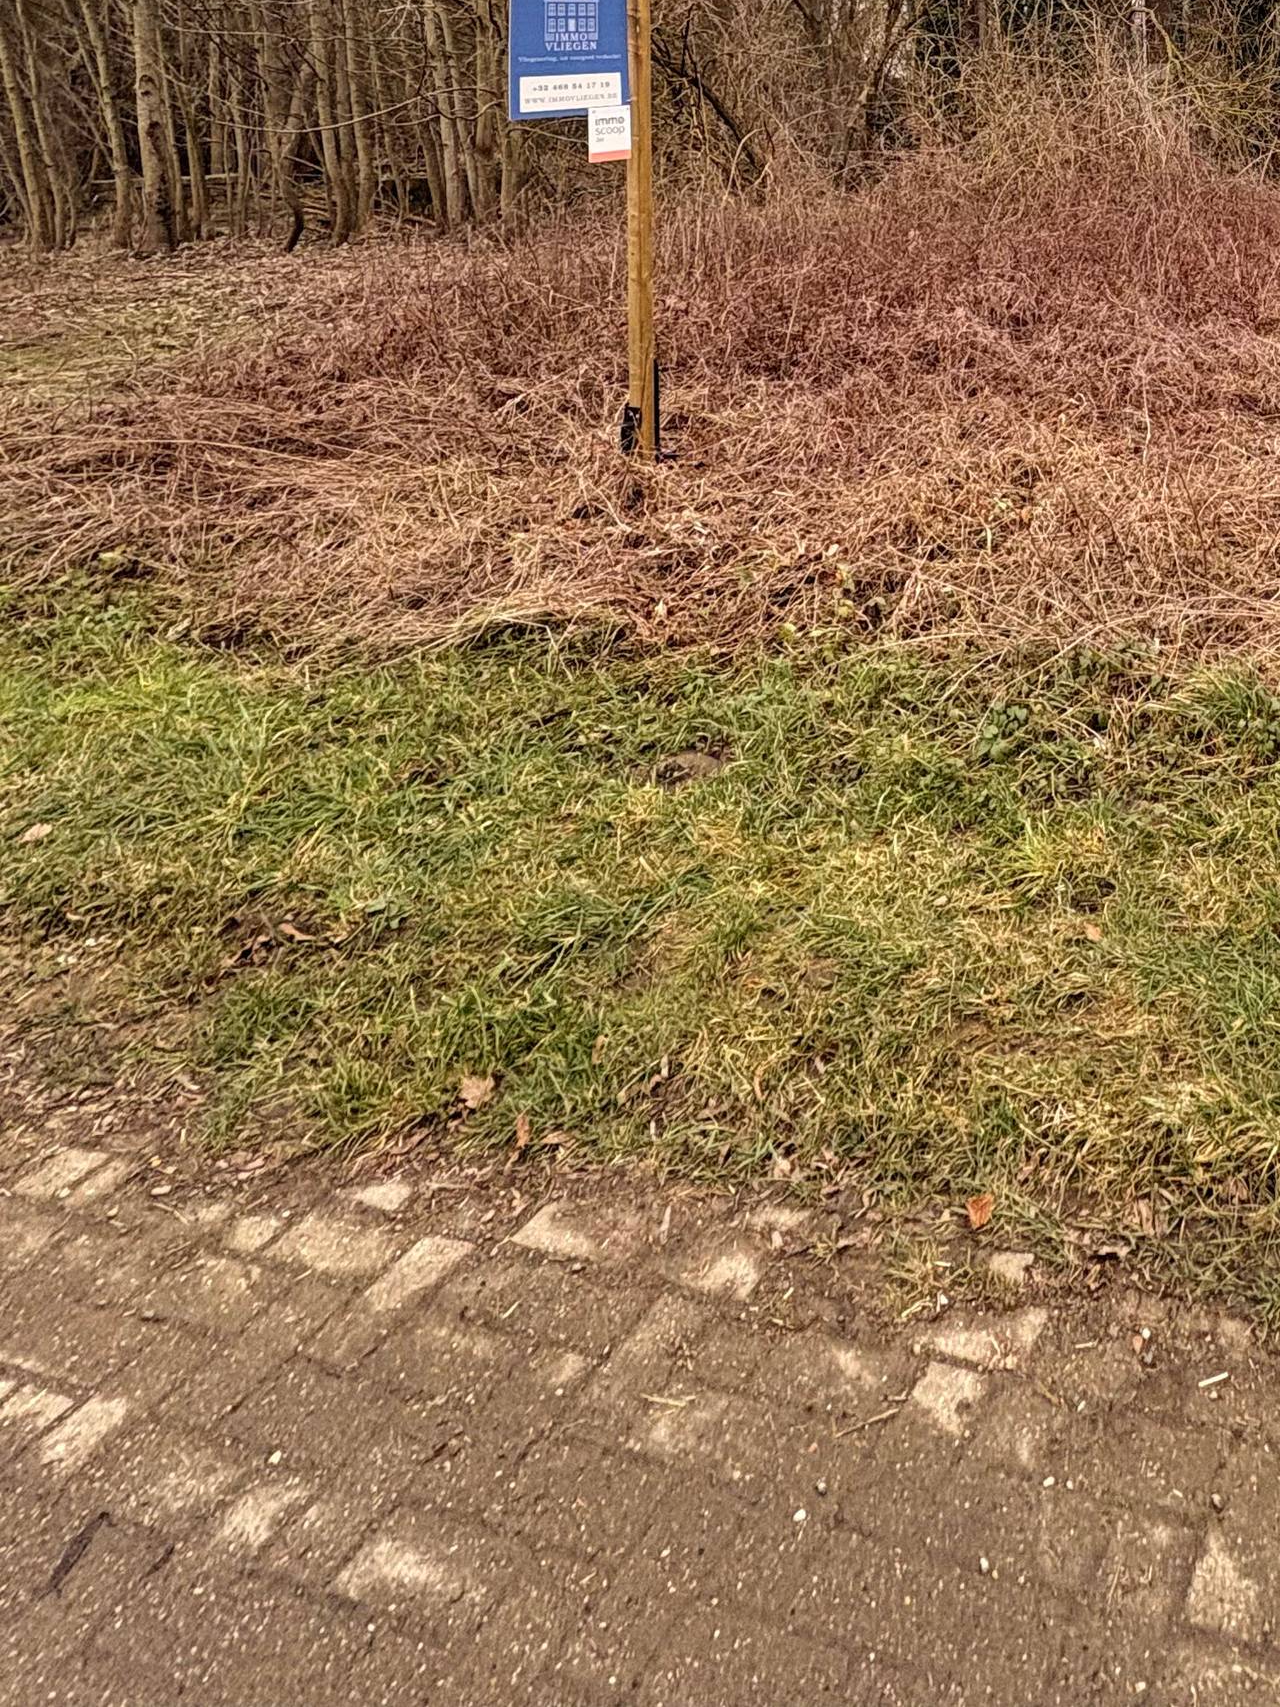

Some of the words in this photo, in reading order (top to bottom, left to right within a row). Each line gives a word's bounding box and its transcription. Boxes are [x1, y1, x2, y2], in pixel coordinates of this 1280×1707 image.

[555, 32, 588, 42] IMMO
[545, 41, 597, 52] VLIEGEN
[595, 116, 625, 126] immo
[595, 126, 626, 136] scoop
